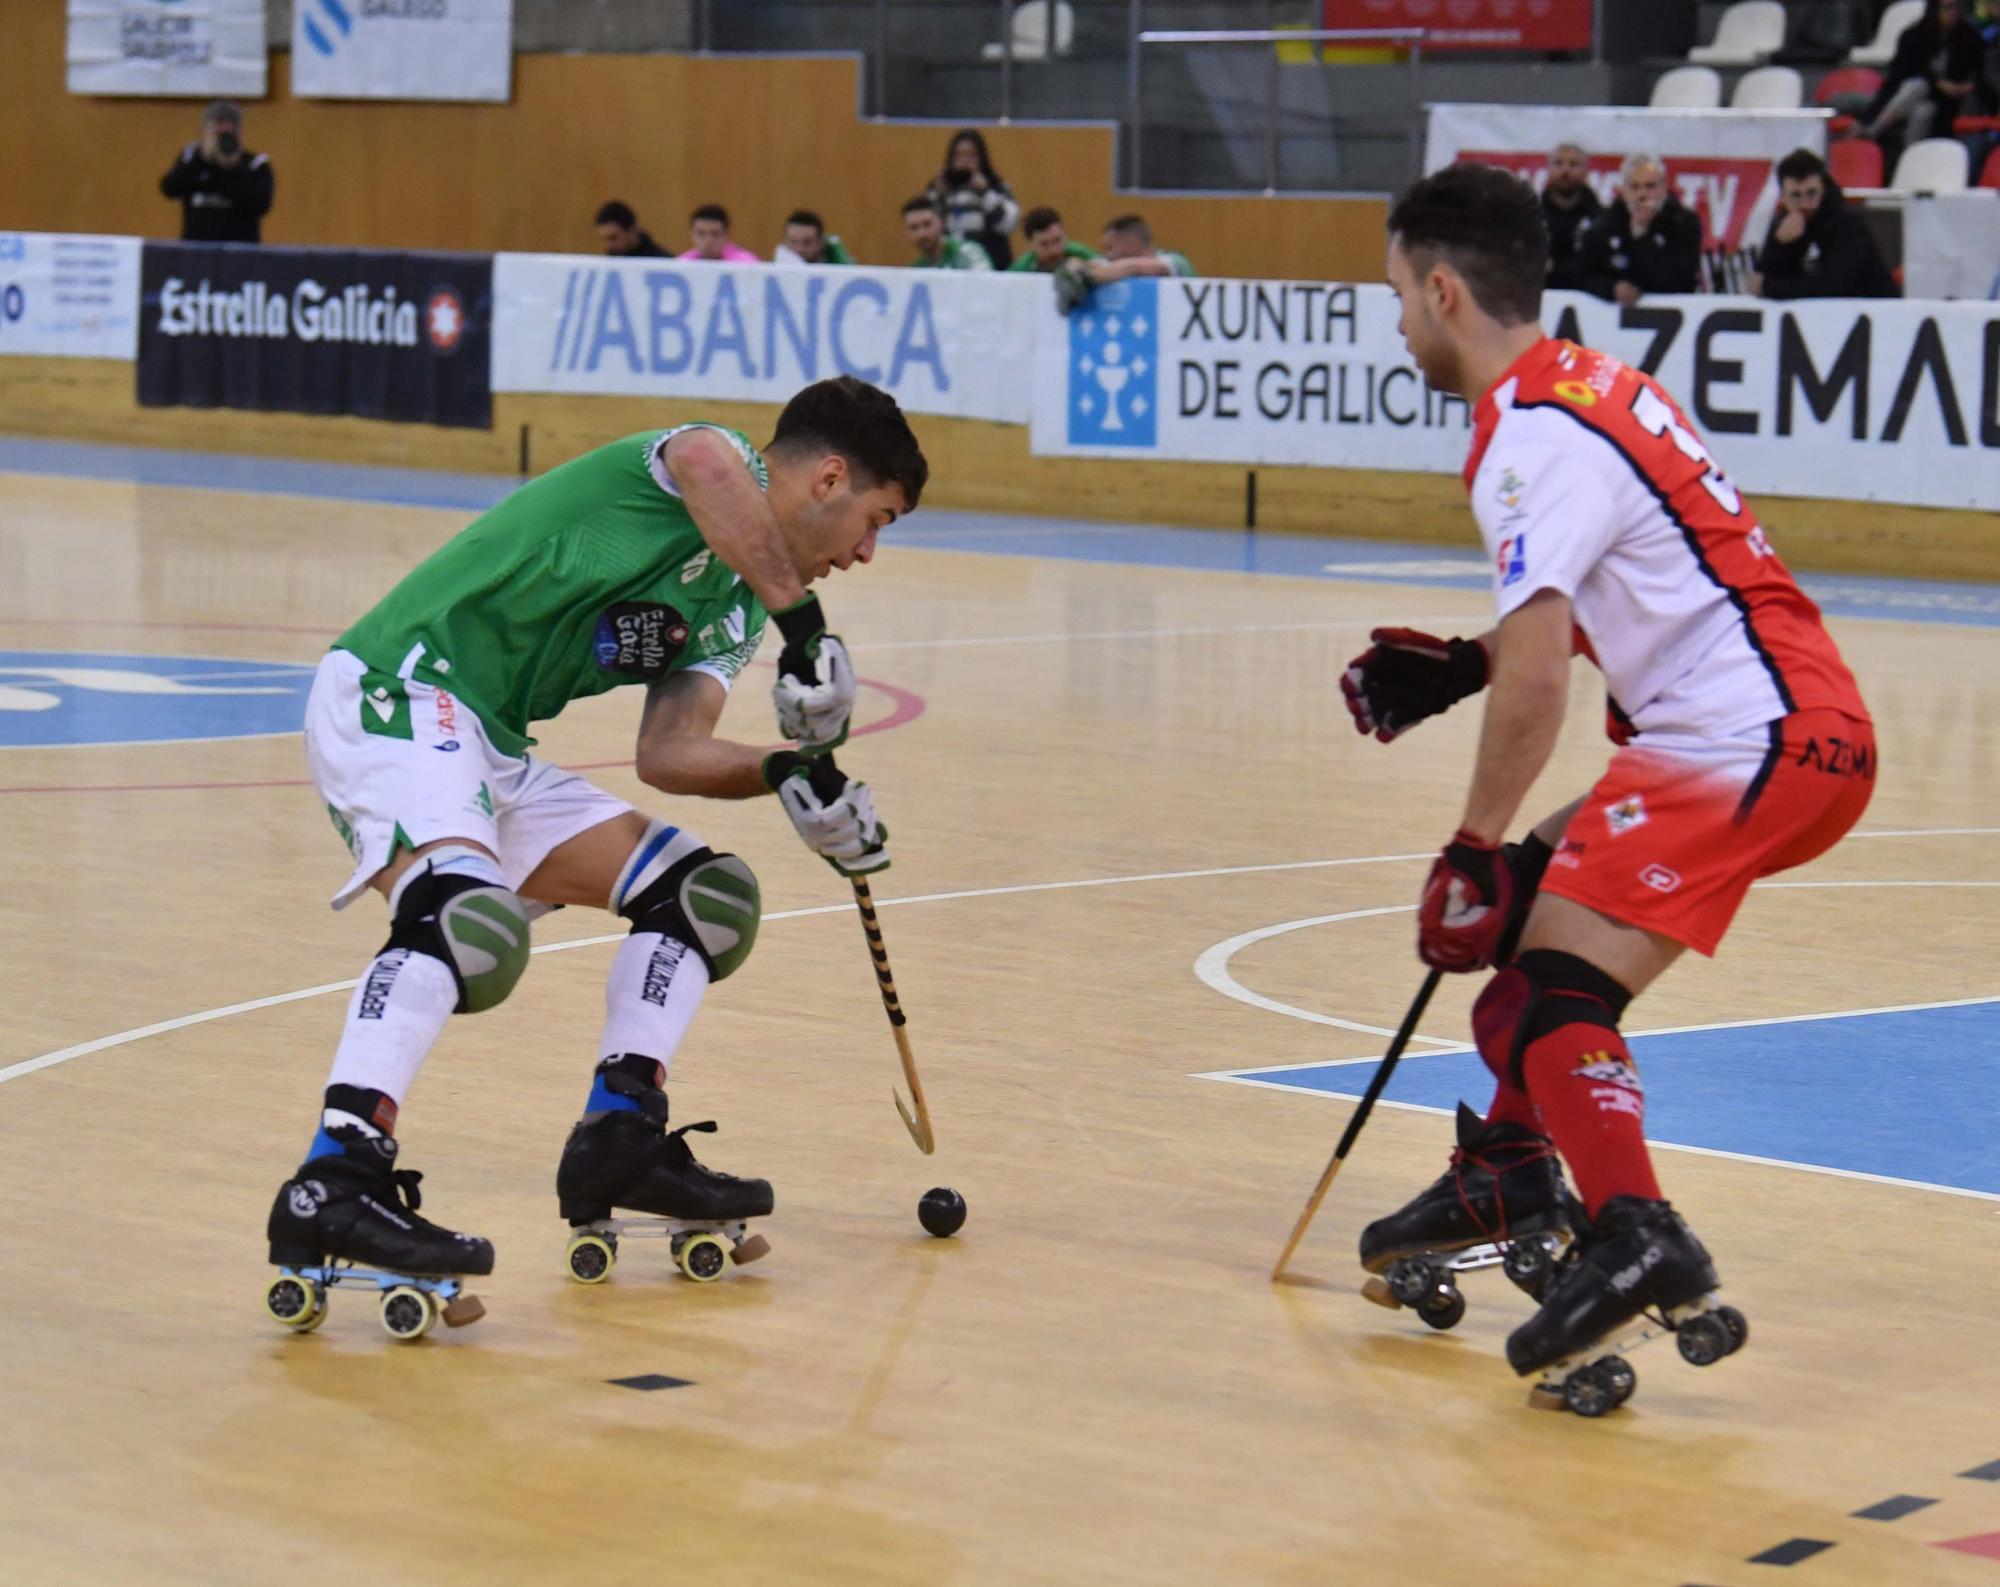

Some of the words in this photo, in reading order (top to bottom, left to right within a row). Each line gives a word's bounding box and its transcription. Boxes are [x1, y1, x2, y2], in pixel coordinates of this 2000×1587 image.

[159, 277, 289, 336] Estrella
[292, 279, 418, 347] Galicia
[1180, 284, 1358, 343] XUNTA
[1179, 360, 1241, 418] DE
